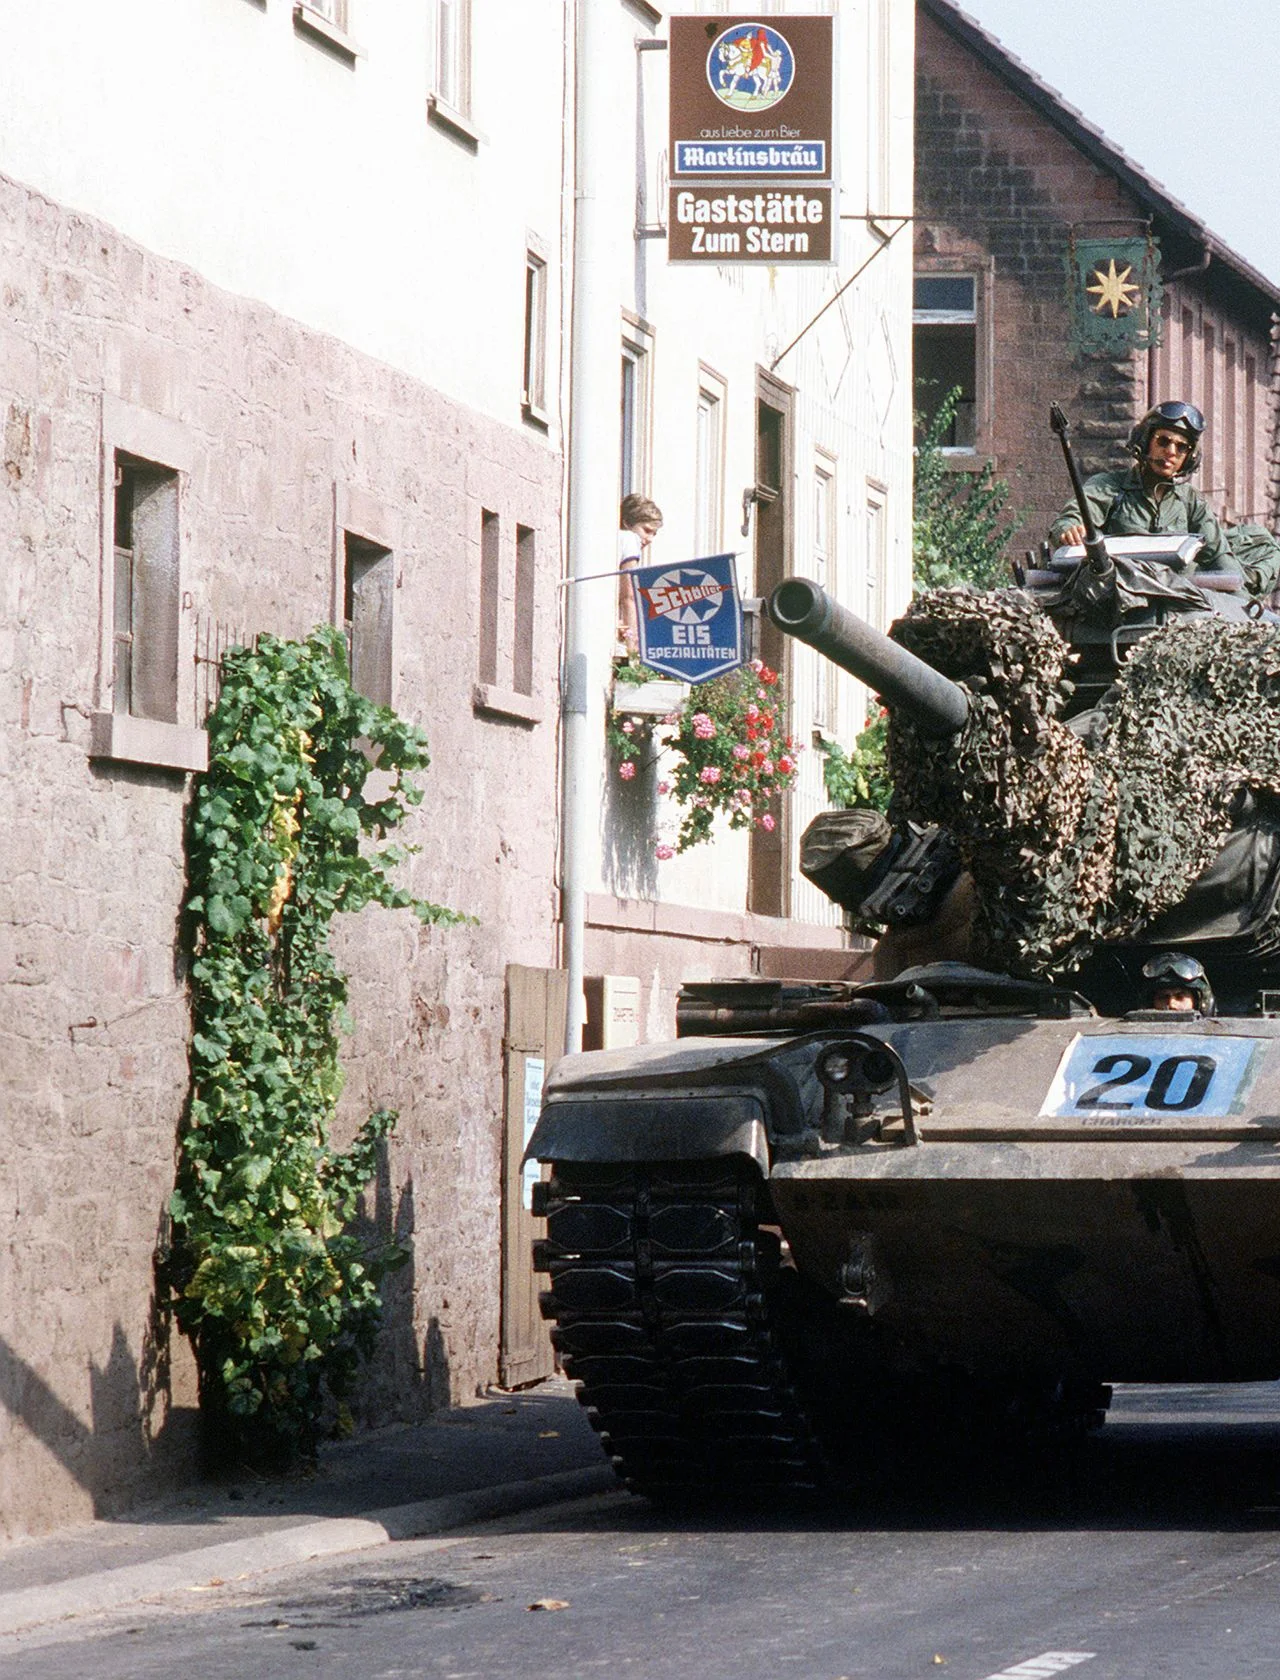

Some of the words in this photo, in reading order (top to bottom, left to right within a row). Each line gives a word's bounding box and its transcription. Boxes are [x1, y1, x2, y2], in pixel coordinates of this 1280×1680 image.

[700, 128, 721, 139] aus
[722, 124, 752, 139] Liebe
[754, 128, 779, 139] zum
[780, 124, 801, 139] Bier
[683, 146, 818, 167] Martinsbräu
[677, 192, 823, 224] Gaststätte
[691, 226, 740, 253] Zum
[746, 226, 809, 253] Stern
[647, 585, 722, 615] Schöller
[672, 625, 711, 646] EIS
[648, 645, 736, 660] SPEZIALITÄTEN
[1075, 1054, 1217, 1112] 20
